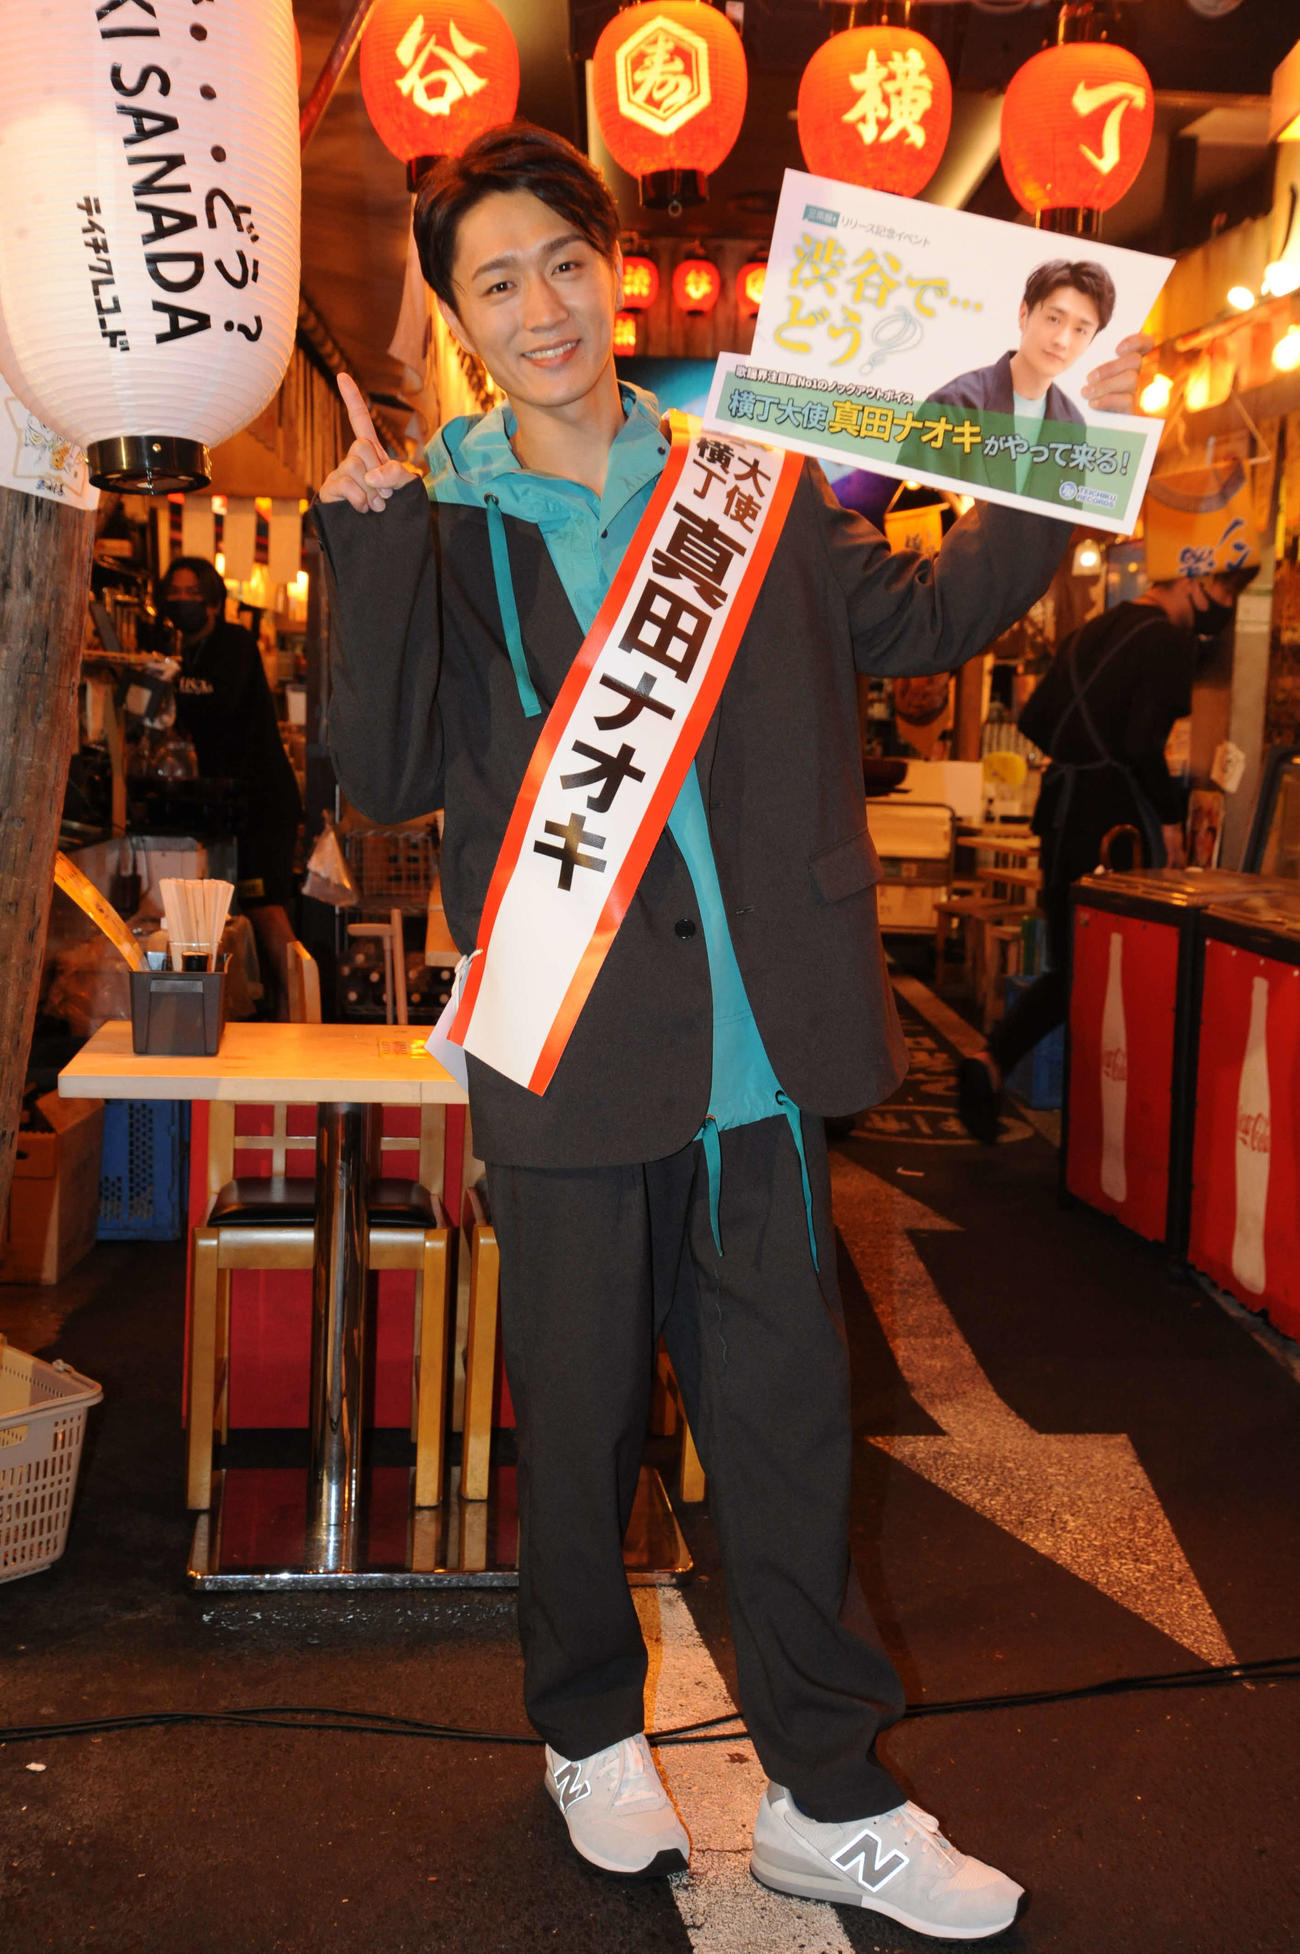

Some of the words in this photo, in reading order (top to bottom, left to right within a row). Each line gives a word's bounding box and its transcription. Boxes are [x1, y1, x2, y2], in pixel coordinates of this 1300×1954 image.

[396, 14, 487, 116] 谷
[842, 48, 934, 148] 横
[1072, 80, 1146, 175] 丁
[110, 62, 211, 344] SANADA
[533, 501, 747, 892] 真田ナオキ
[831, 1829, 909, 1892] N
